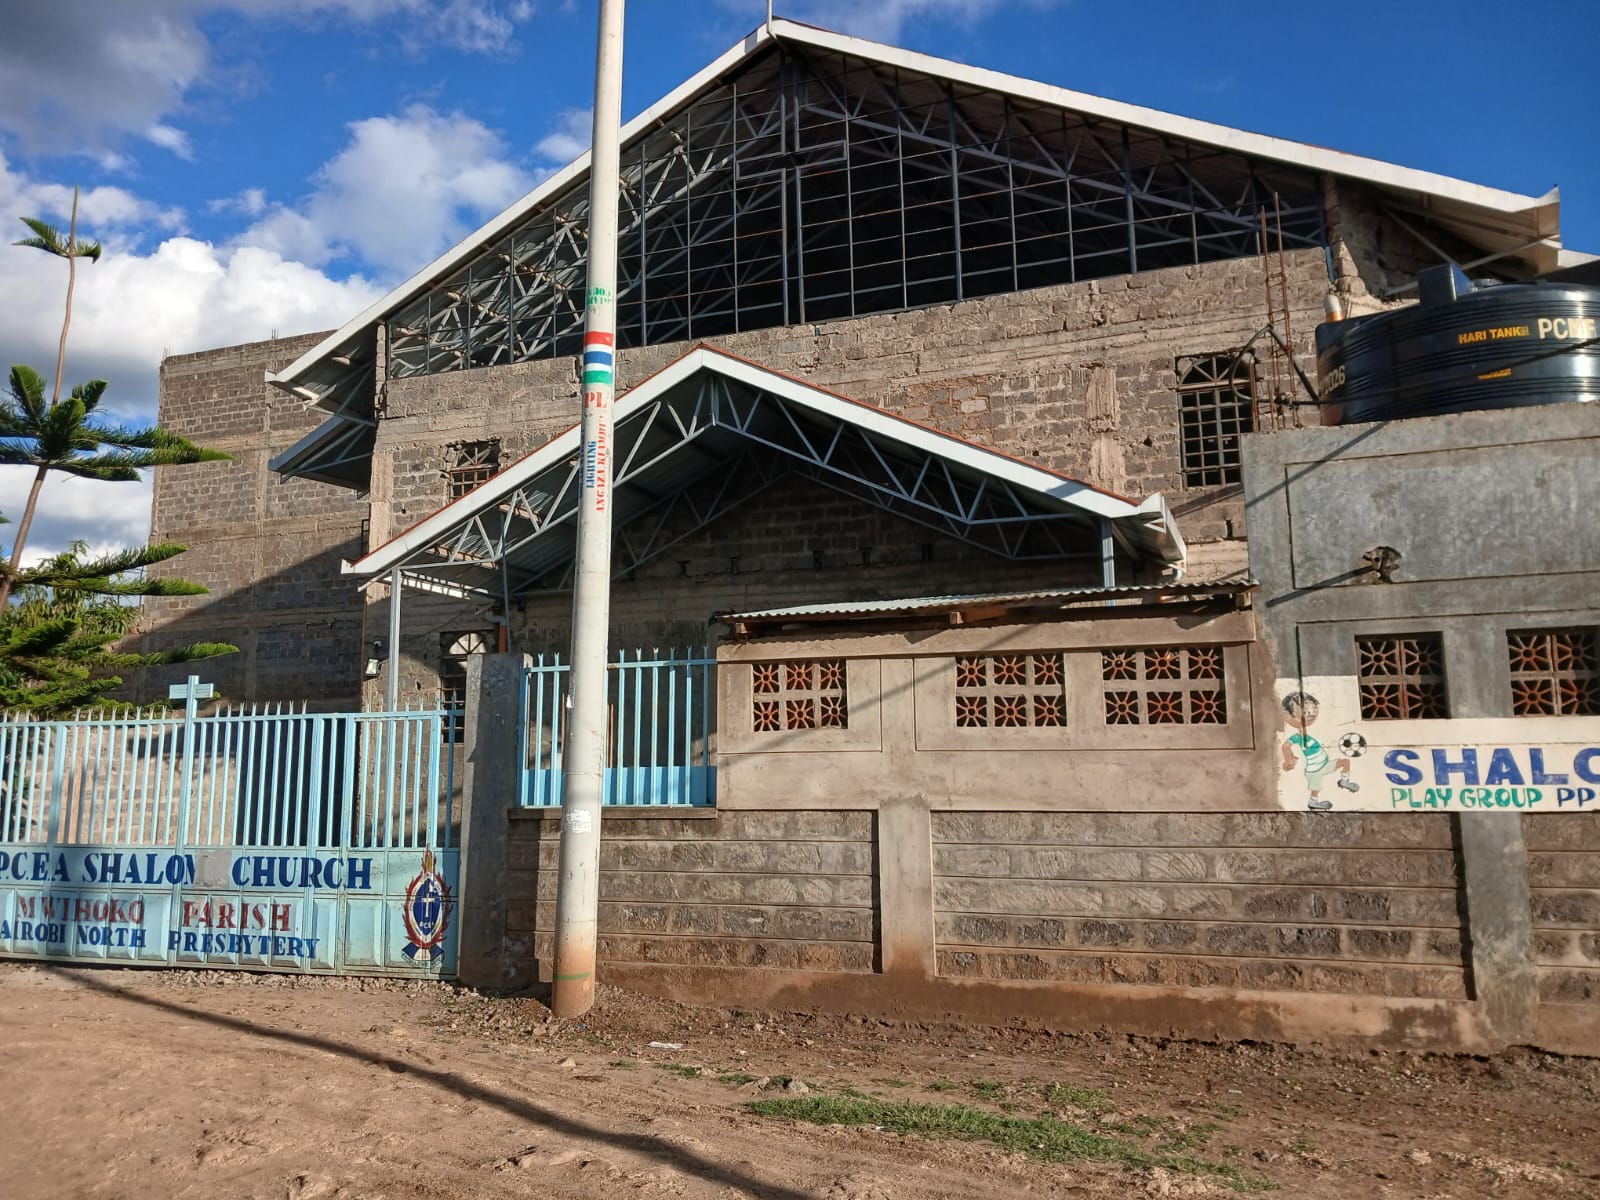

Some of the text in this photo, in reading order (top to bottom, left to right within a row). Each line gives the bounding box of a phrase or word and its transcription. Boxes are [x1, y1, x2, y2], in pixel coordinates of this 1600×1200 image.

[1458, 329, 1487, 345] HARI
[585, 440, 597, 489] LIGHTING
[1391, 787, 1452, 808] PLAY
[1459, 787, 1543, 808] GROUP
[232, 856, 373, 889] CHURCH
[18, 895, 145, 925] MWIHOKO
[76, 925, 147, 948] NORTH
[168, 930, 321, 959] PRESBYTERY
